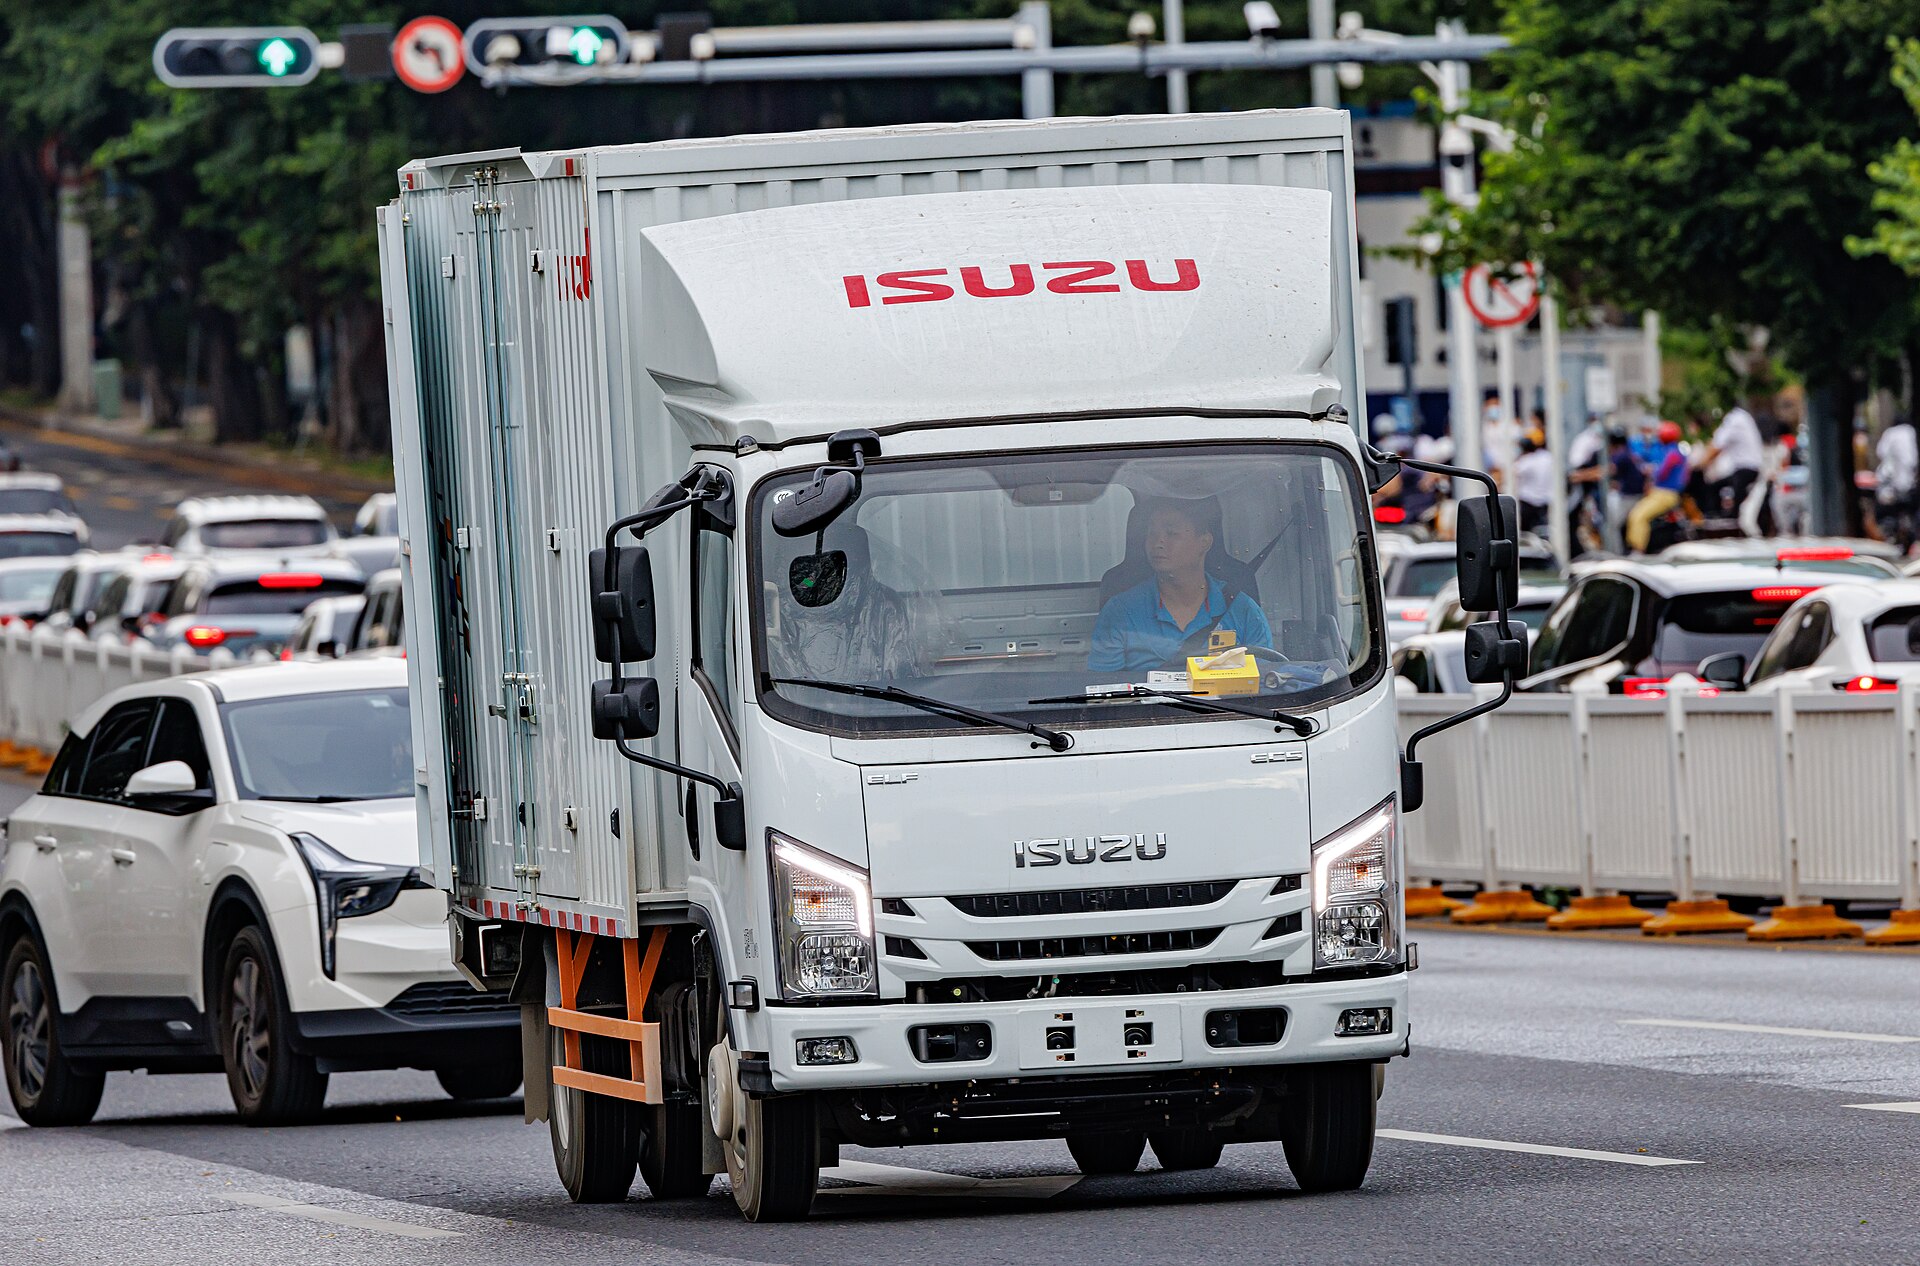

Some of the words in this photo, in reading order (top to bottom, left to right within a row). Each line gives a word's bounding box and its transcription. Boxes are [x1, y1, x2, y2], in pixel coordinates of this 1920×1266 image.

[843, 258, 1201, 308] ISUZU
[867, 773, 919, 786] ELF
[1014, 832, 1167, 868] ISUZU
